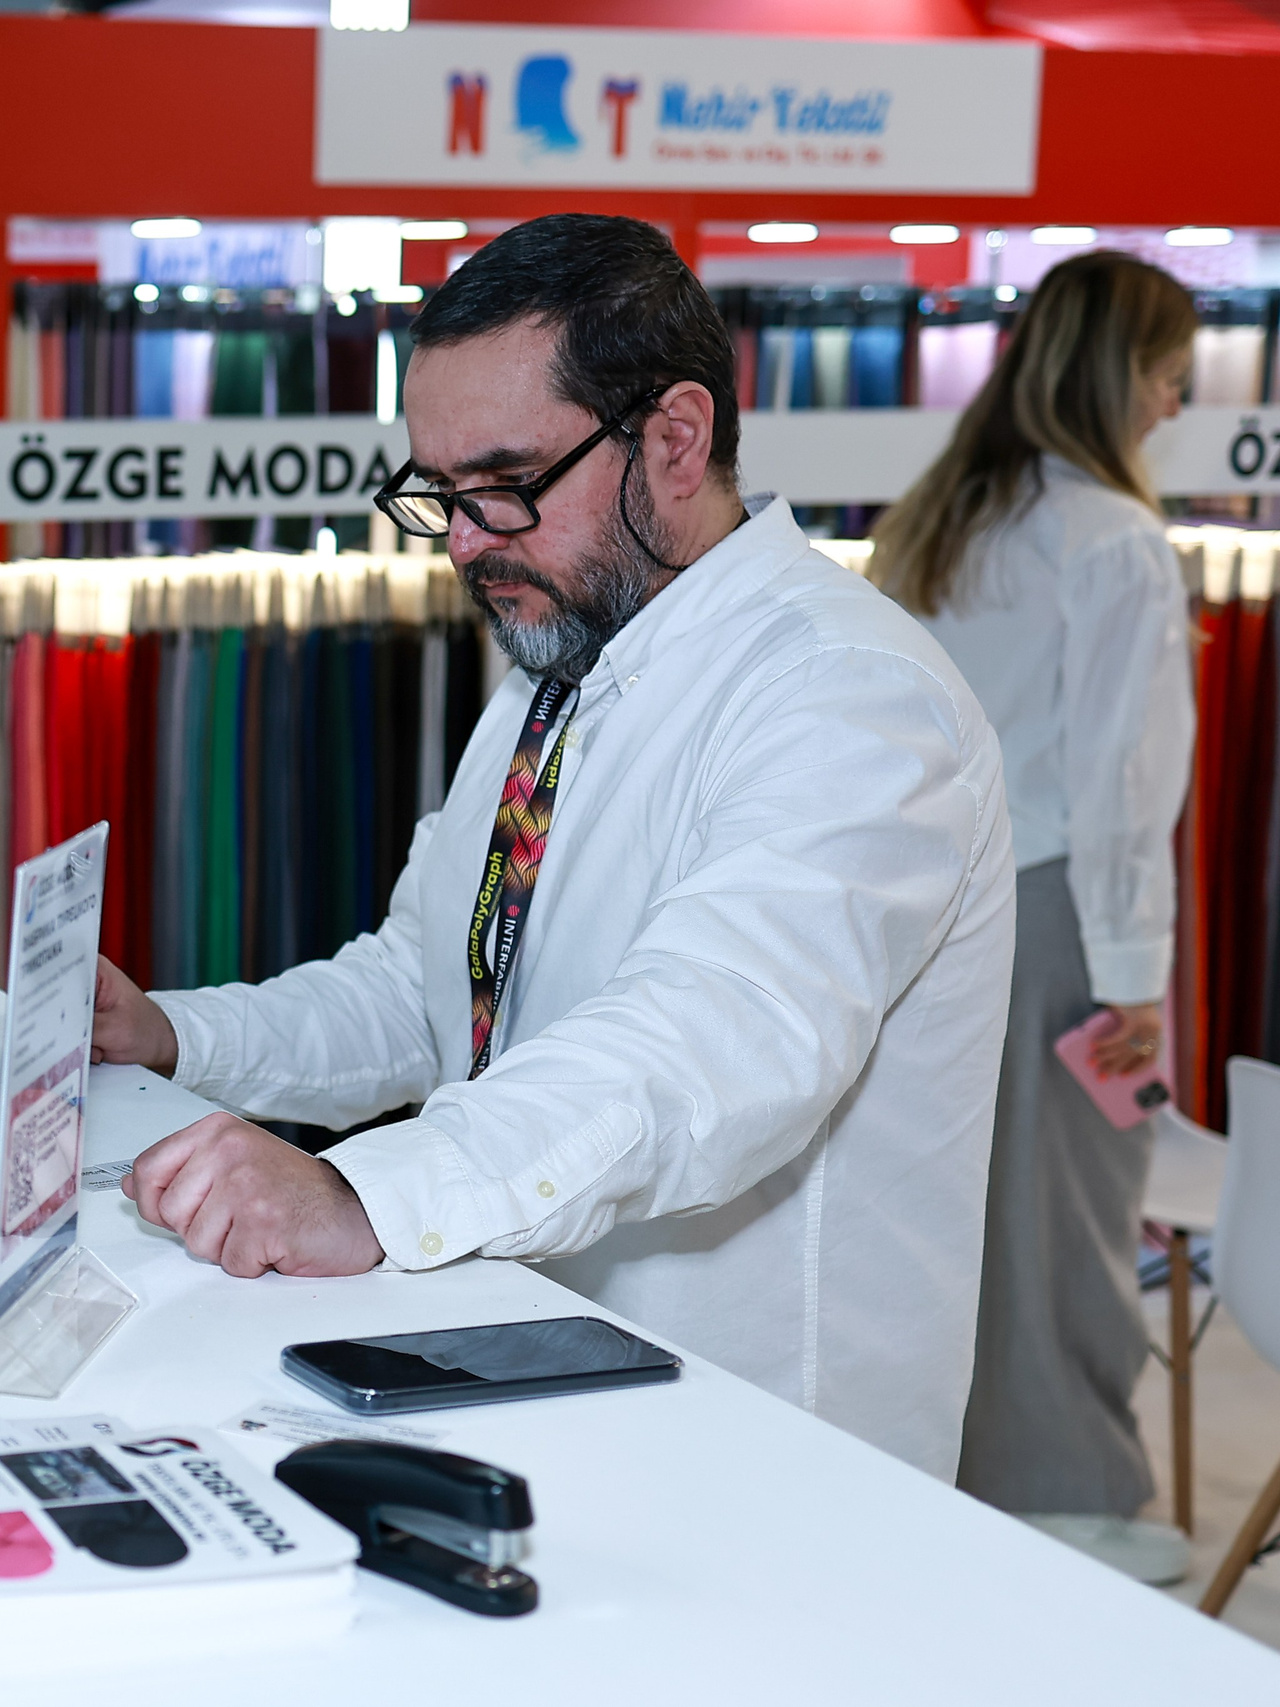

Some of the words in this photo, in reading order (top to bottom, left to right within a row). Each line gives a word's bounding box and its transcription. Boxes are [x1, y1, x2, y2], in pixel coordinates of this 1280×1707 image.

[447, 71, 488, 157] N
[599, 76, 641, 158] T
[10, 433, 184, 503] ÖZGE
[208, 444, 394, 498] MODA
[469, 851, 503, 980] GalaPolyGraph
[227, 1500, 299, 1554] MODA
